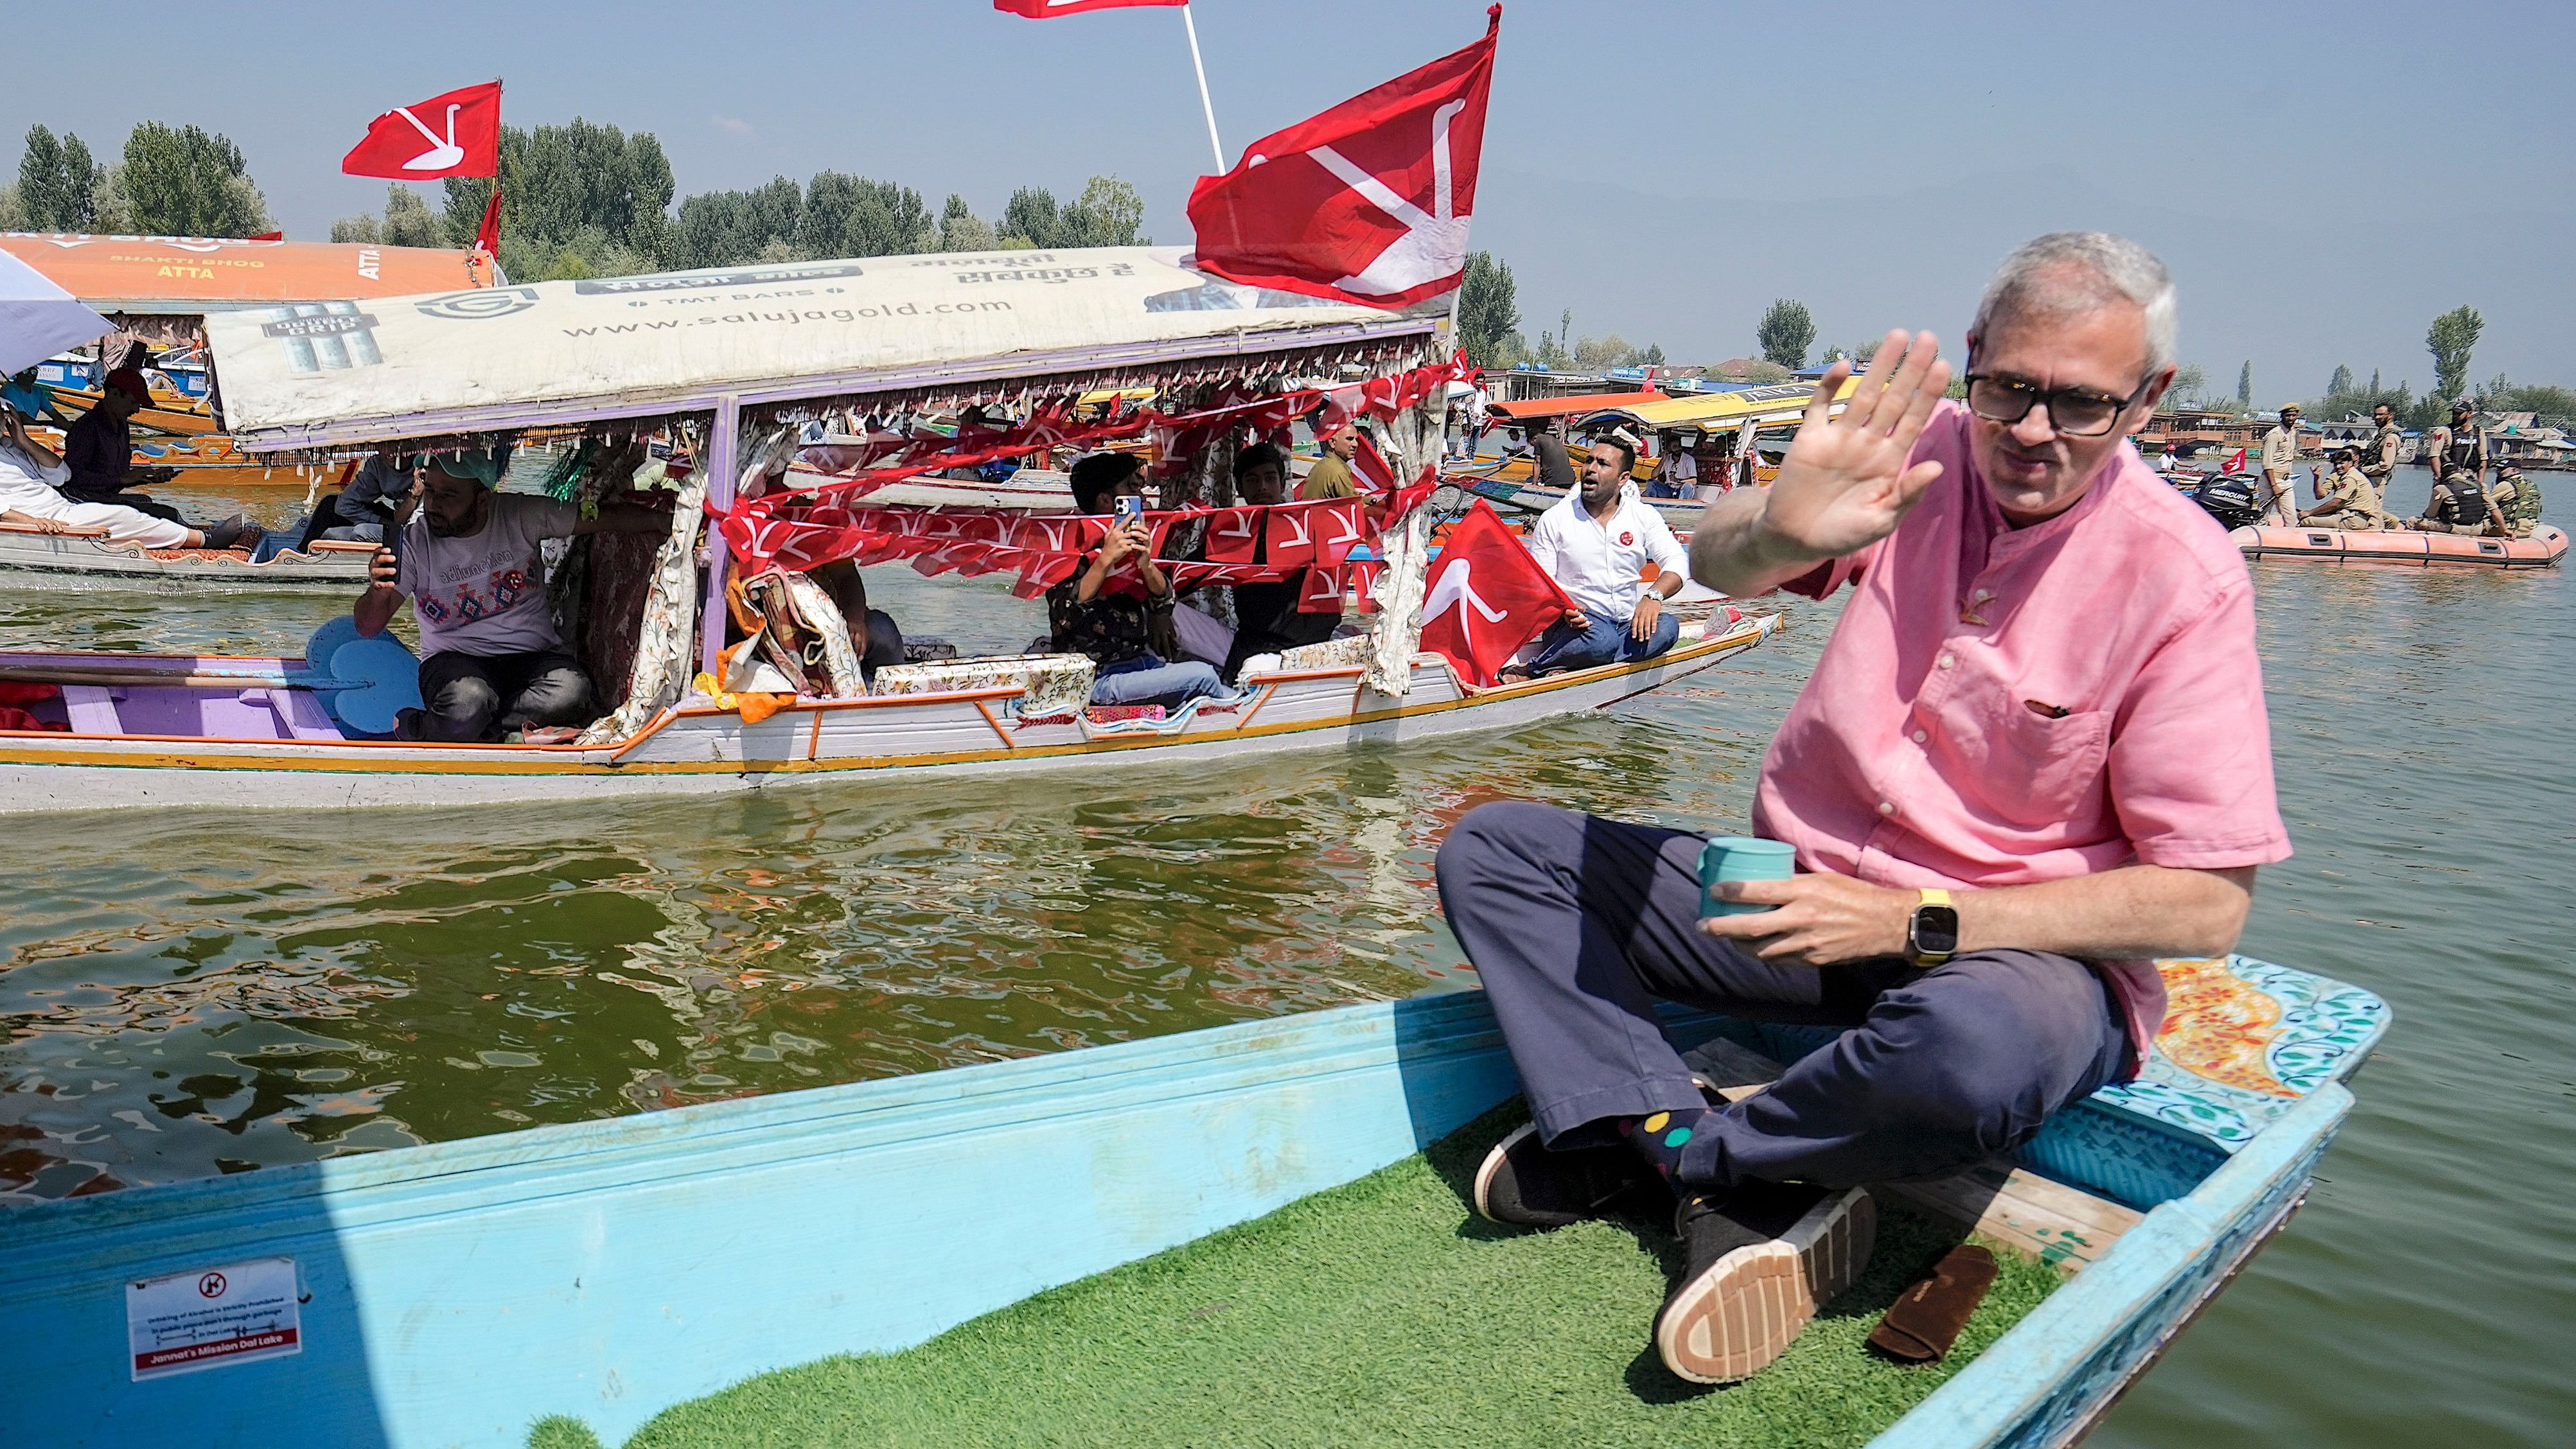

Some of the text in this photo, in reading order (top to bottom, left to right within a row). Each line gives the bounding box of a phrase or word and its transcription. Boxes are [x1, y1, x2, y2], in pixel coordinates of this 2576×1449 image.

[110, 254, 265, 269] SHAKTI BHOG
[358, 249, 381, 281] ATTA
[157, 265, 216, 281] ATTA
[660, 289, 815, 305] TMT BARS
[561, 299, 1012, 338] www.salujagold.com
[288, 321, 357, 336] GRIP
[2209, 488, 2250, 502] MERCURY
[439, 549, 514, 584] adjunction
[150, 1334, 283, 1364] Jannat's Mission Dal Lake
